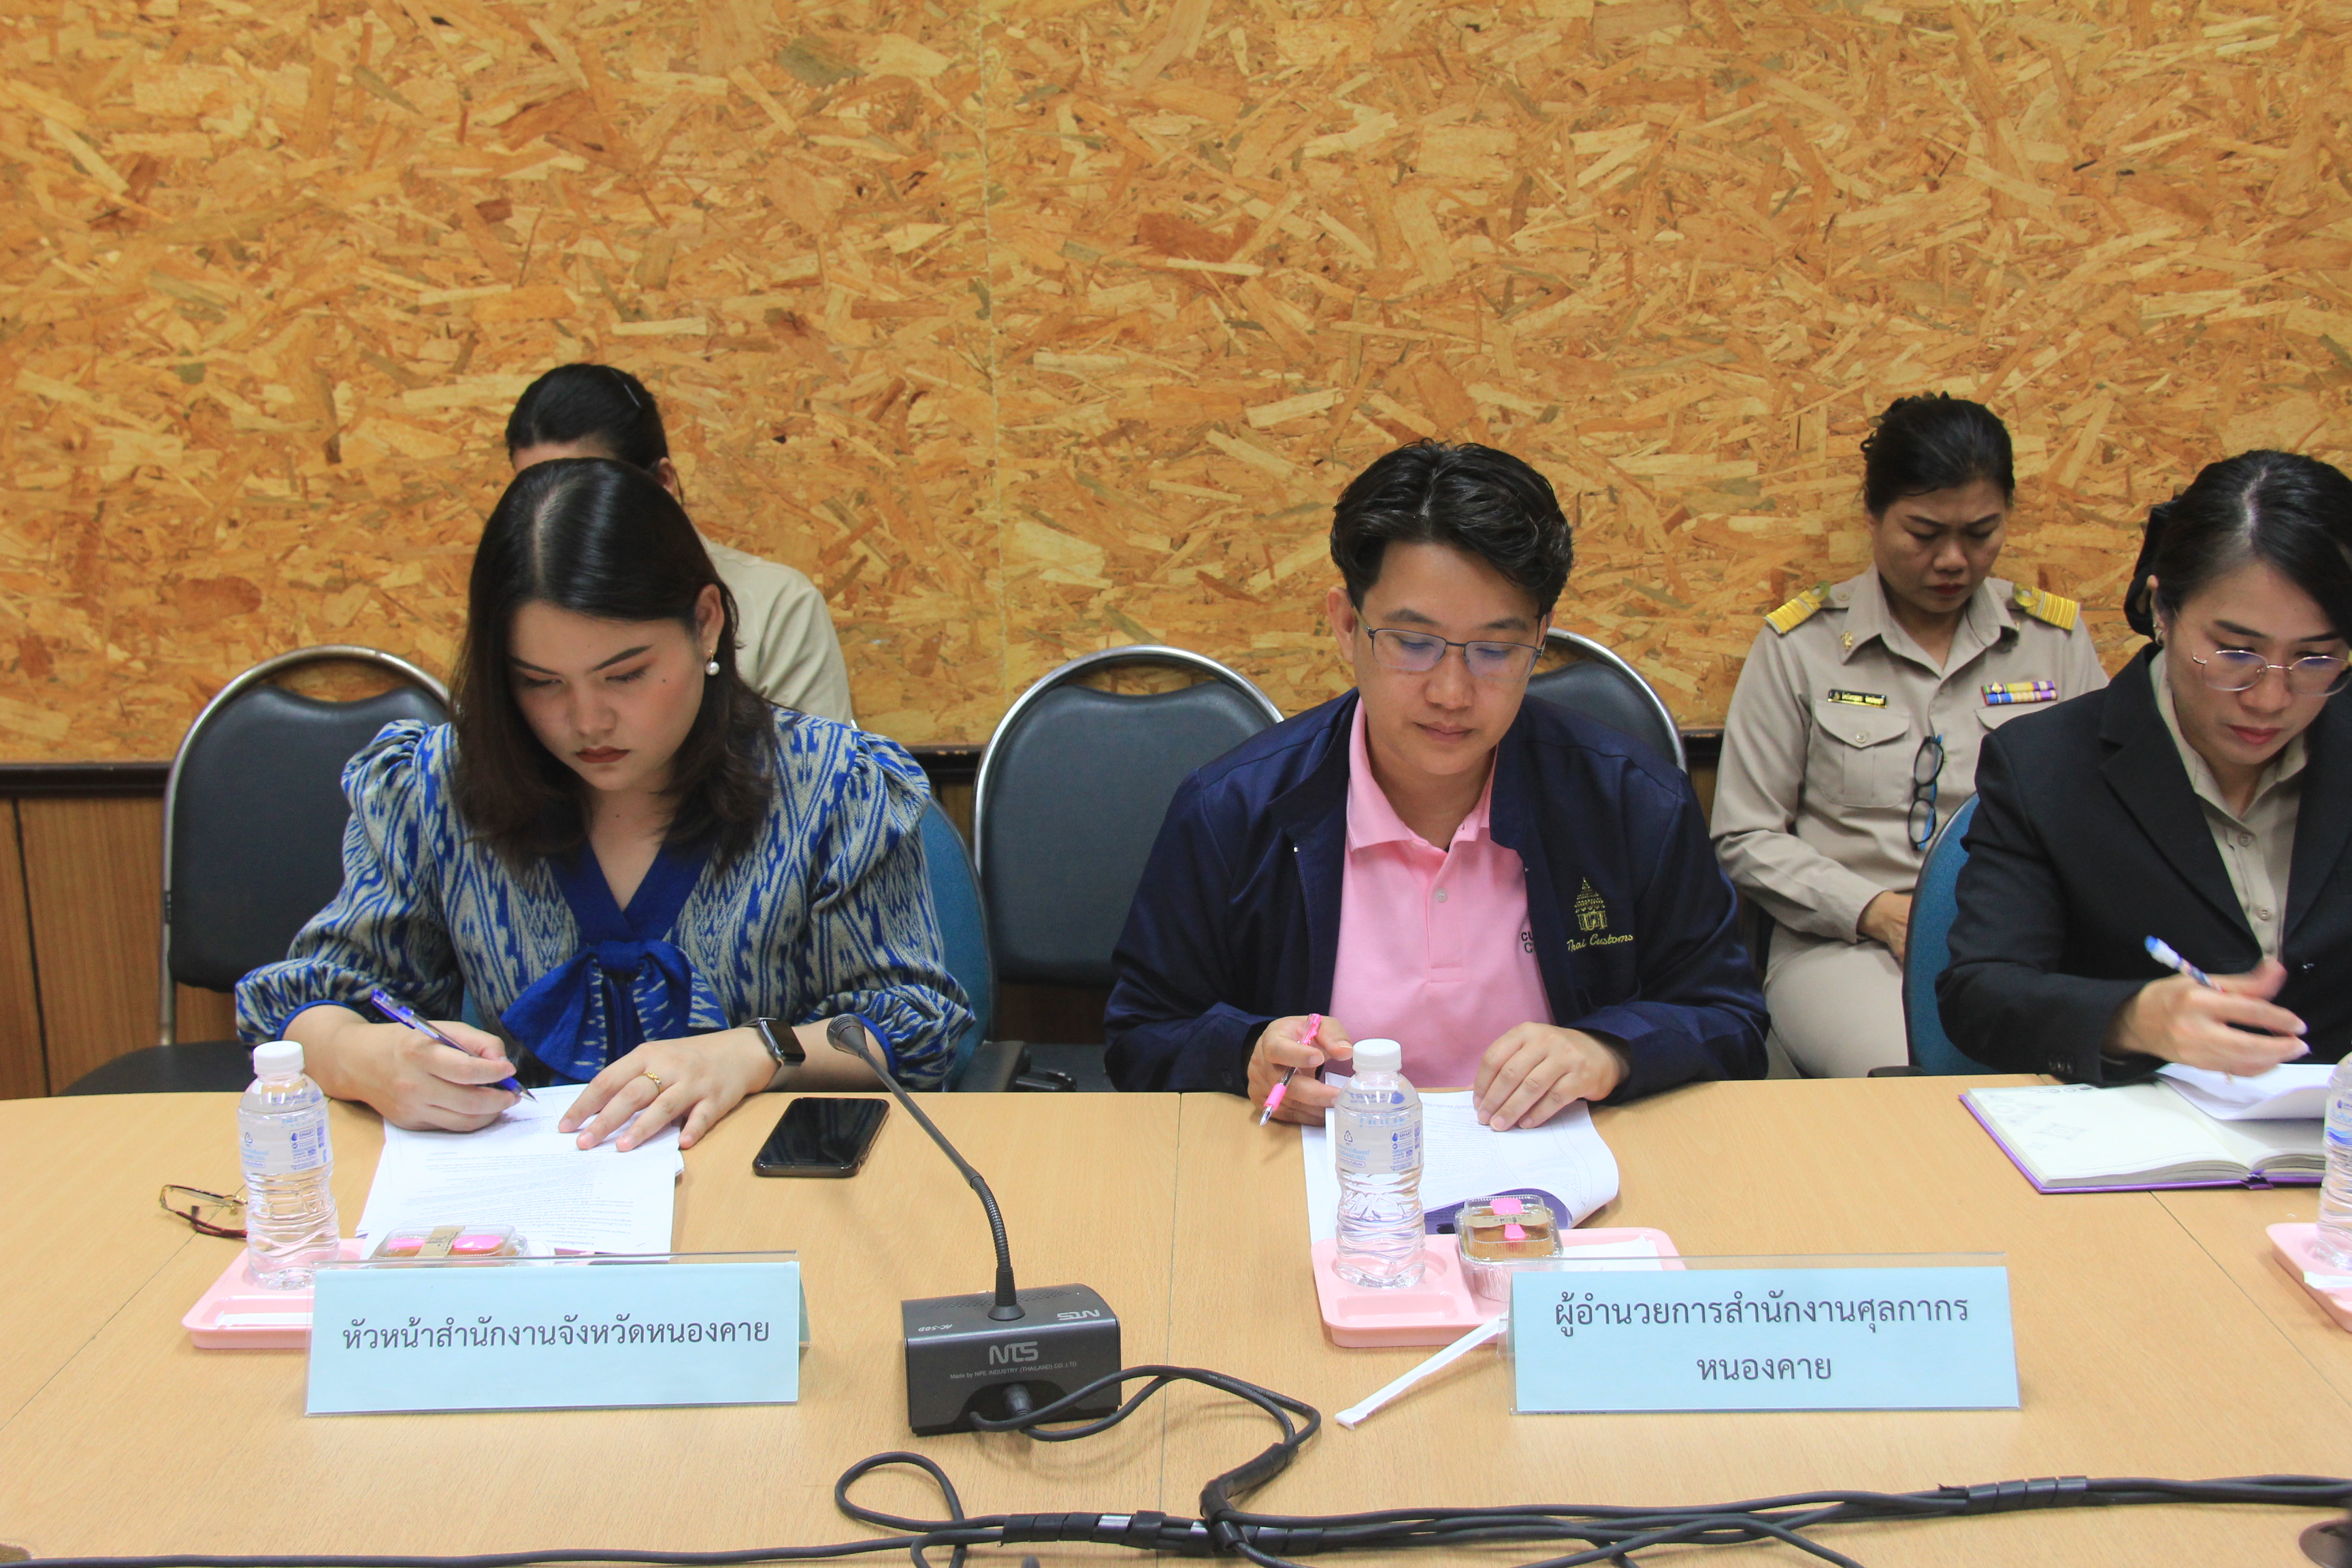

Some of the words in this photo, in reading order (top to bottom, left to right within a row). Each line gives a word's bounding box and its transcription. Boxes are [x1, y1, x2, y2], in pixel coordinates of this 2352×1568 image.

[1567, 939, 1586, 952] Thai
[1590, 933, 1633, 945] Customs
[1057, 1309, 1100, 1320] NTS
[1556, 1290, 1968, 1337] ผู้อำนวยการสำนักงานศุลกากร
[343, 1313, 770, 1349] หัวหน้าสำนักงานจังหวัดหนองคาย
[989, 1341, 1039, 1365] NTS
[989, 1367, 1018, 1375] INDUSTRY
[1019, 1364, 1053, 1372] (THAILAND)
[1697, 1358, 1831, 1380] หนองคาย
